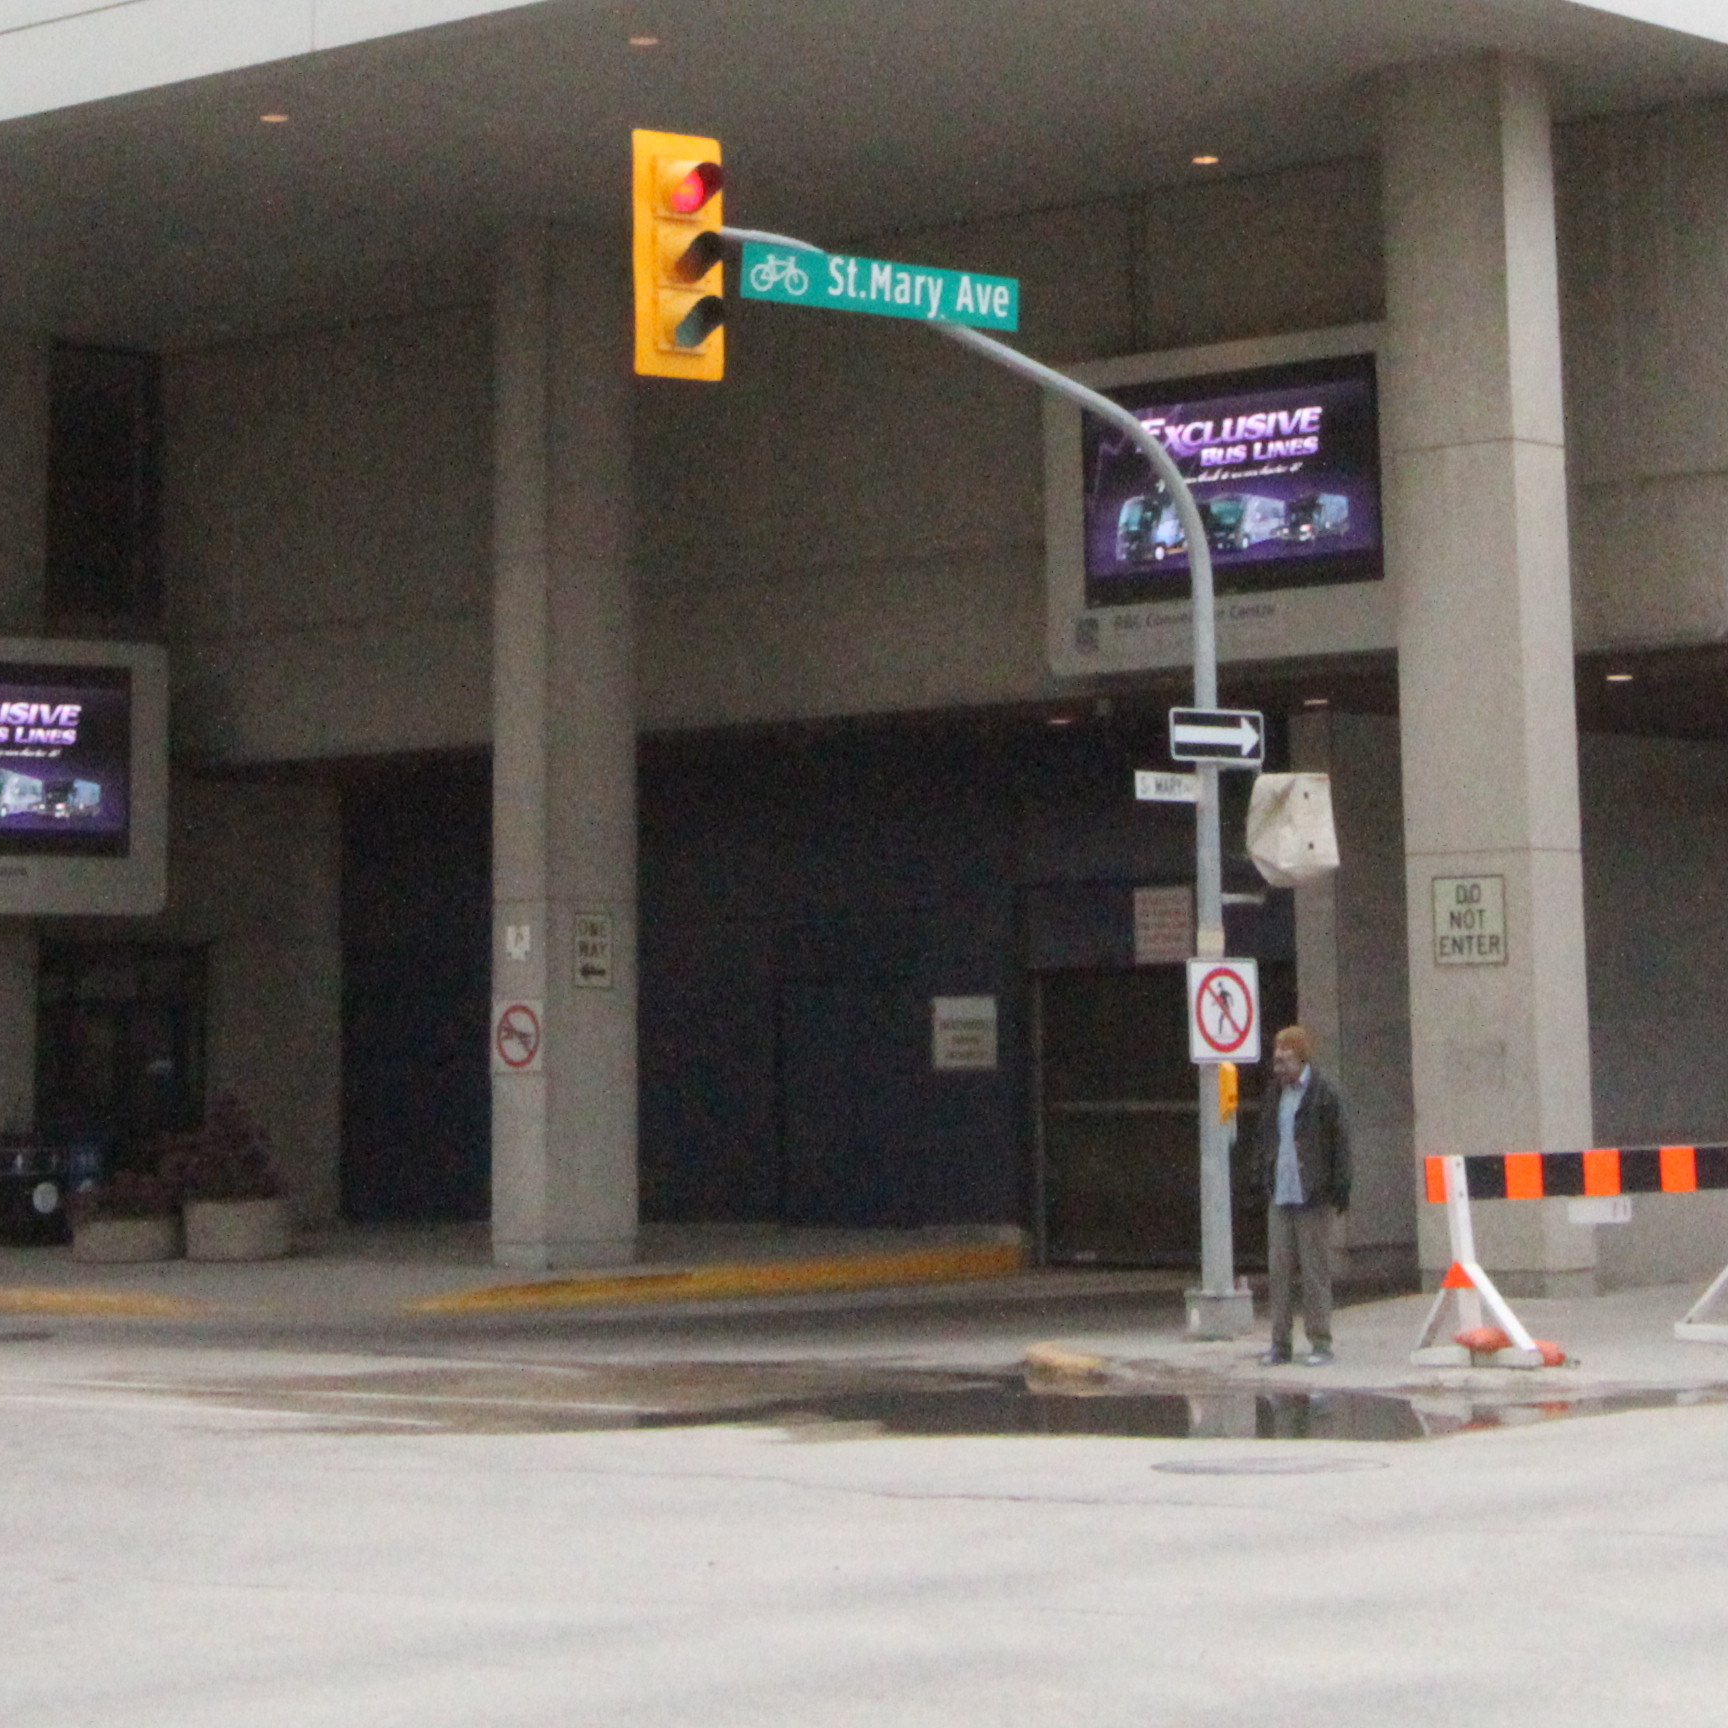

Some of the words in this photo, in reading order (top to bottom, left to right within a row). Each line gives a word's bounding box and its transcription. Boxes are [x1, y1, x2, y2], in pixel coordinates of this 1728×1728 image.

[954, 275, 1010, 318] Ave
[1200, 445, 1248, 467] BUS
[1253, 436, 1320, 461] LINES
[14, 726, 77, 745] LINES
[1154, 776, 1183, 795] MARY
[1455, 883, 1482, 905] DO
[1449, 907, 1487, 930] NOT
[578, 940, 609, 958] WAY
[1438, 934, 1501, 957] ENTER
